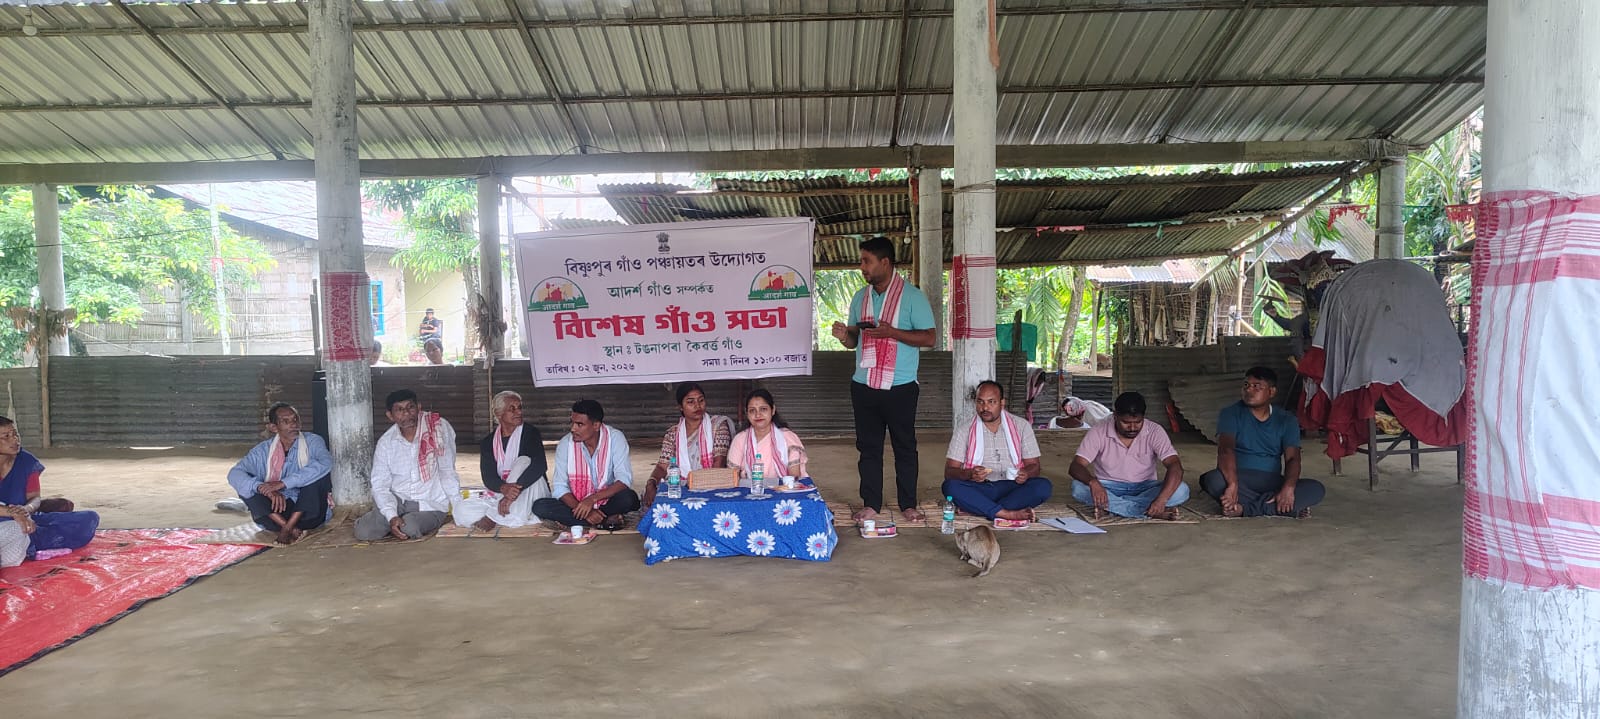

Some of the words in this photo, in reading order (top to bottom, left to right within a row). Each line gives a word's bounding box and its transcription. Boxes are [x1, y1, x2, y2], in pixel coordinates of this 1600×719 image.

[616, 255, 642, 272] গাঁও
[646, 255, 705, 271] পঞ্চায়তৰ
[708, 251, 767, 267] উদ্যোগত
[648, 280, 672, 297] গাঁও
[552, 311, 646, 340] বিশেষ
[655, 304, 716, 334] গাঁও
[725, 306, 788, 331] সভা
[602, 344, 623, 359] স্থান
[722, 336, 744, 351] গাঁও
[578, 364, 590, 373] ০২
[611, 362, 636, 373] ২০২৬
